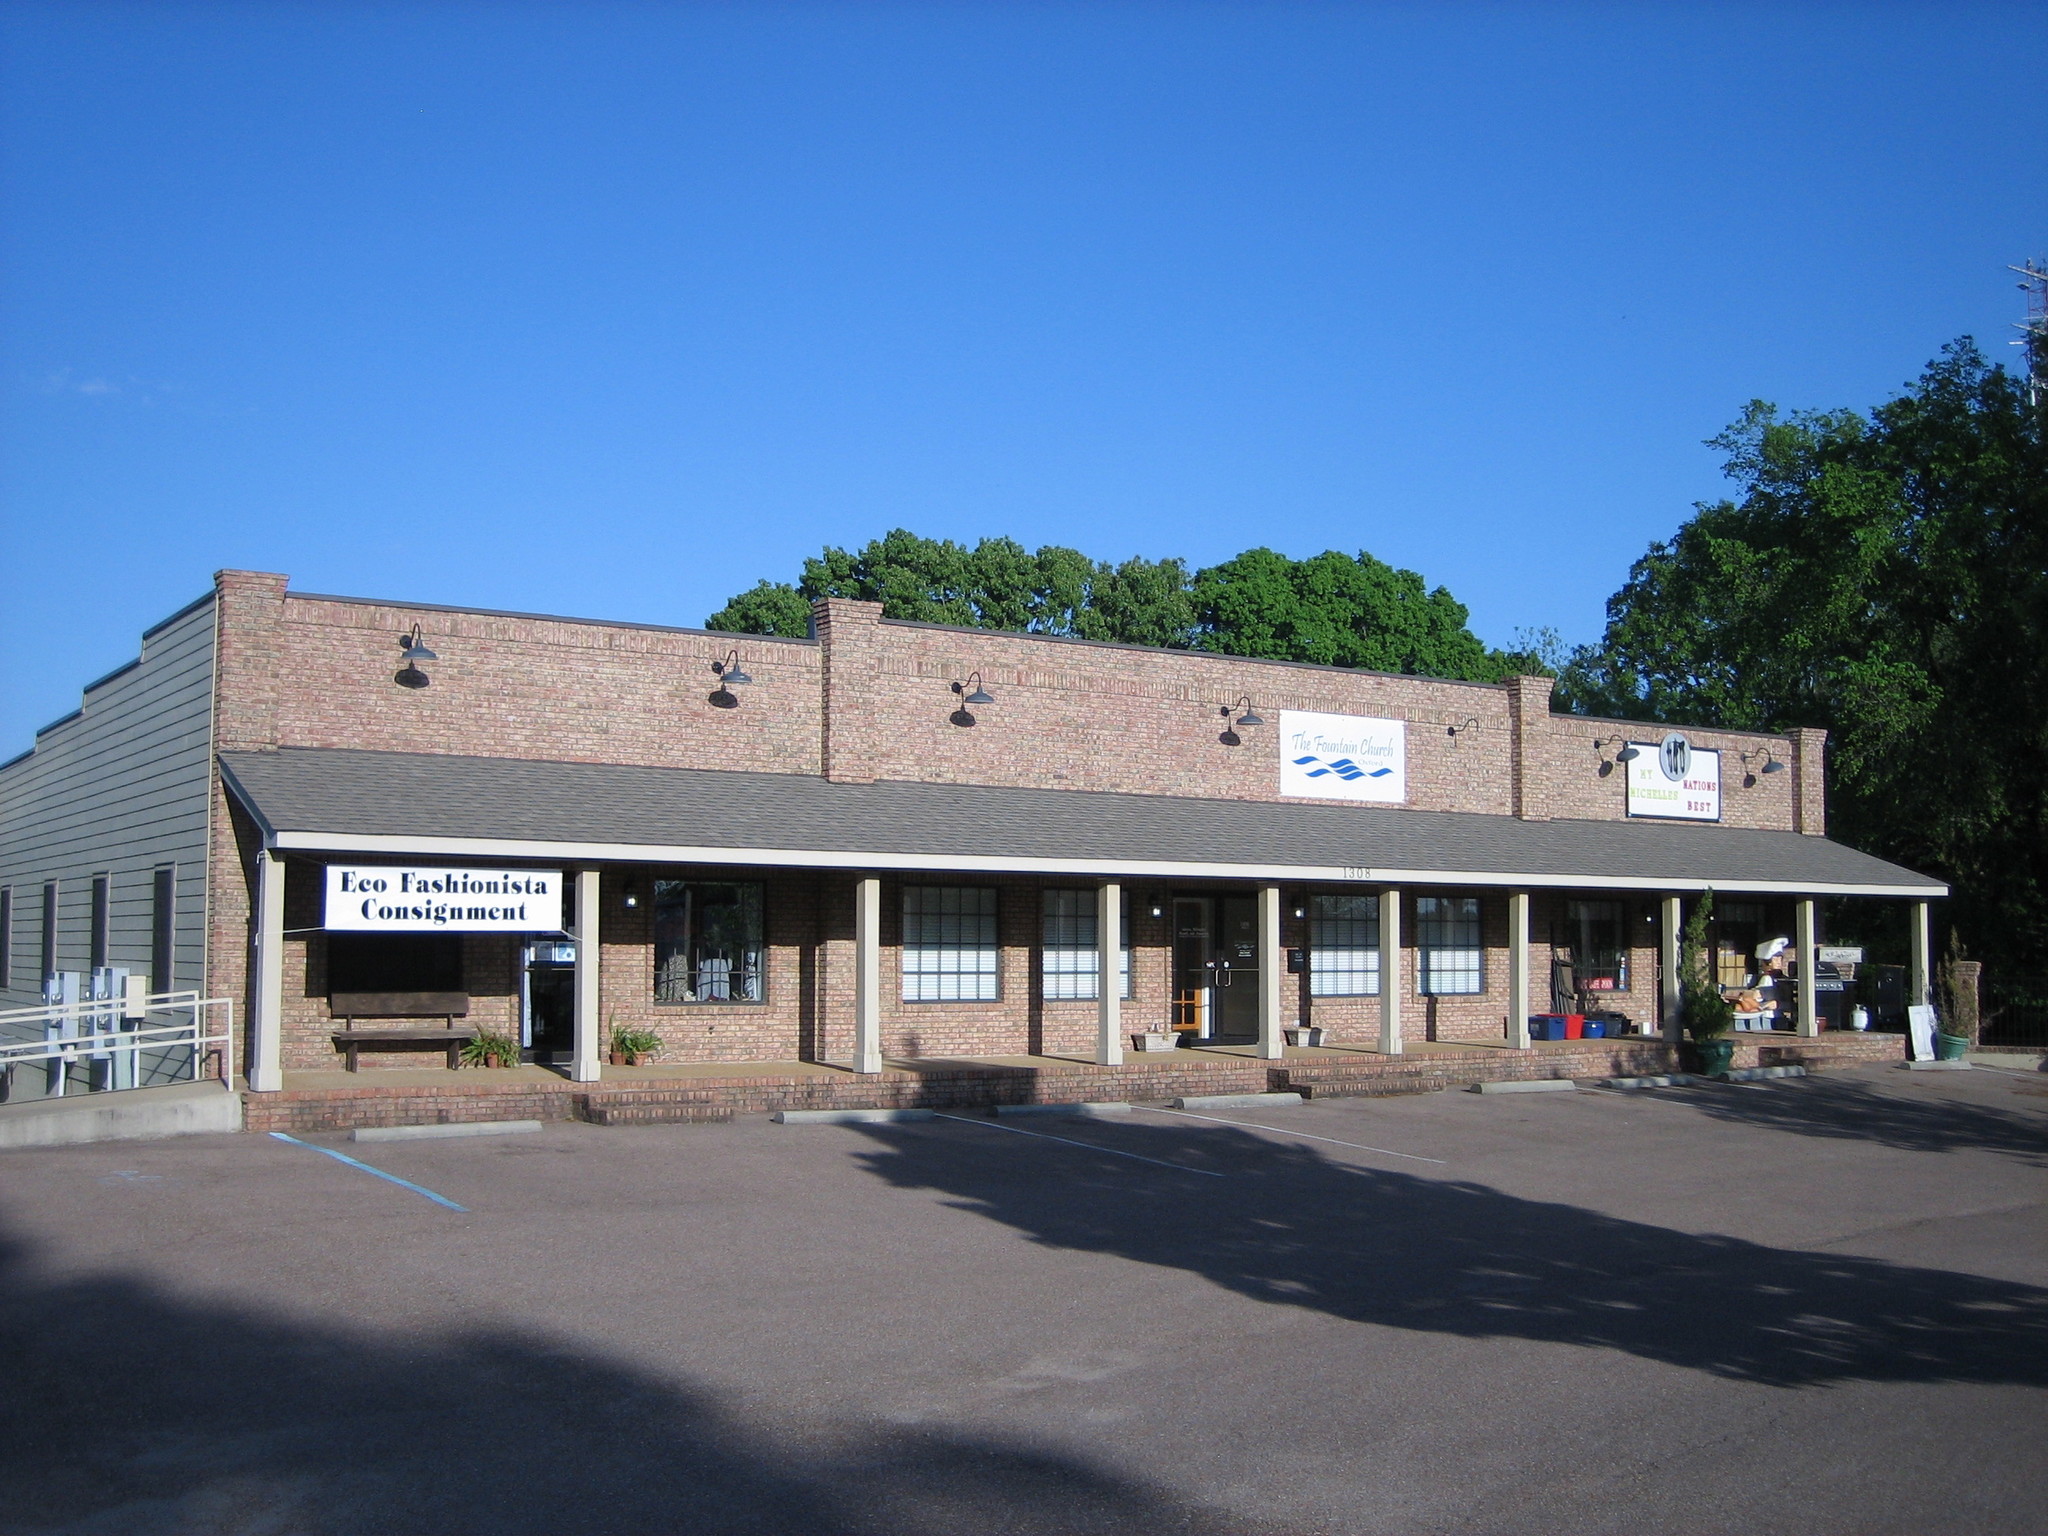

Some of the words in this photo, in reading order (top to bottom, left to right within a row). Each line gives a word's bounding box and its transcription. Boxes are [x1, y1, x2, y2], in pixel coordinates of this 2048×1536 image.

[1291, 730, 1311, 751] The
[1314, 735, 1358, 755] Fountain
[1360, 736, 1394, 757] Church
[1640, 769, 1653, 780] MY
[1683, 779, 1717, 792] NATIONS
[1630, 787, 1679, 800] MICHELLES
[1687, 800, 1712, 812] BEST
[1343, 866, 1371, 879] 1308
[340, 871, 388, 893] Eco
[400, 872, 549, 895] Fashionista
[361, 898, 529, 925] Consignment
